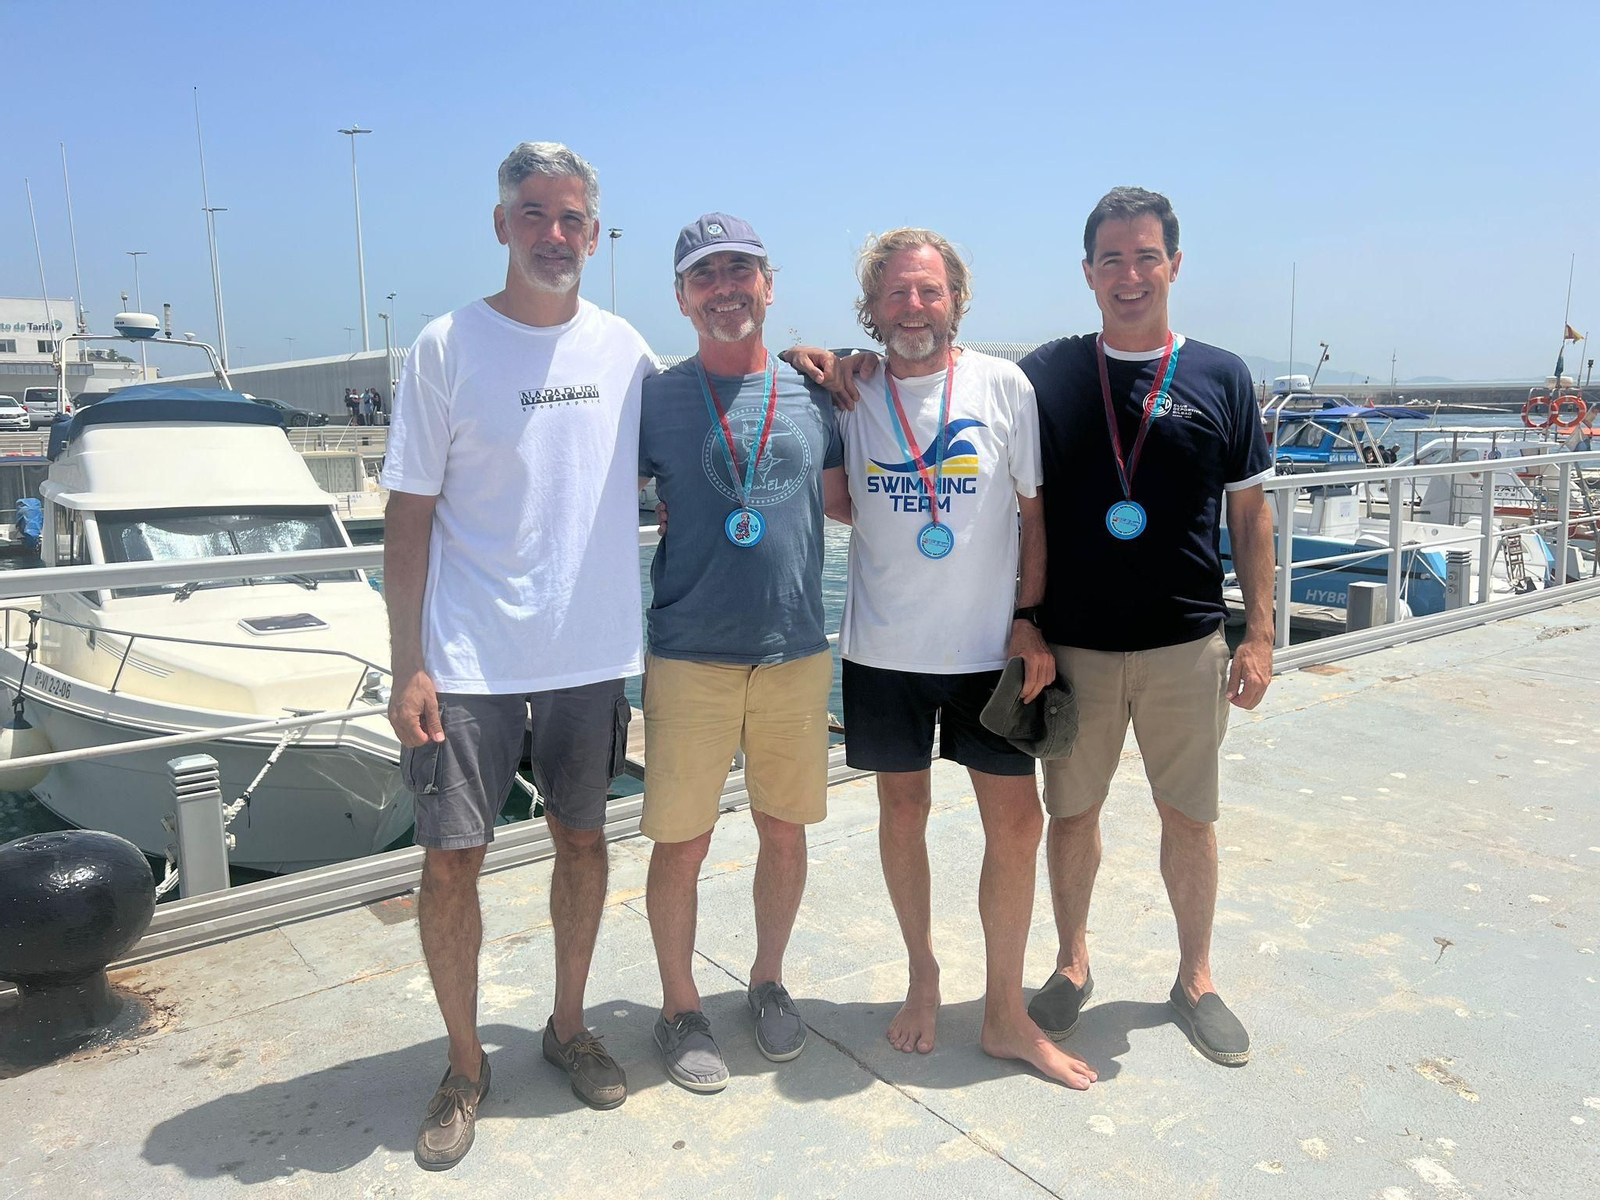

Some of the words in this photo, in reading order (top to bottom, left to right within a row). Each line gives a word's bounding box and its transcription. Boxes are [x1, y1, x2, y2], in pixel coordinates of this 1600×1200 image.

[13, 322, 26, 330] de
[520, 384, 599, 405] NAPAPIJRI
[867, 476, 977, 494] SWIMMING
[889, 495, 951, 513] TEAM
[1305, 589, 1347, 605] HYBR
